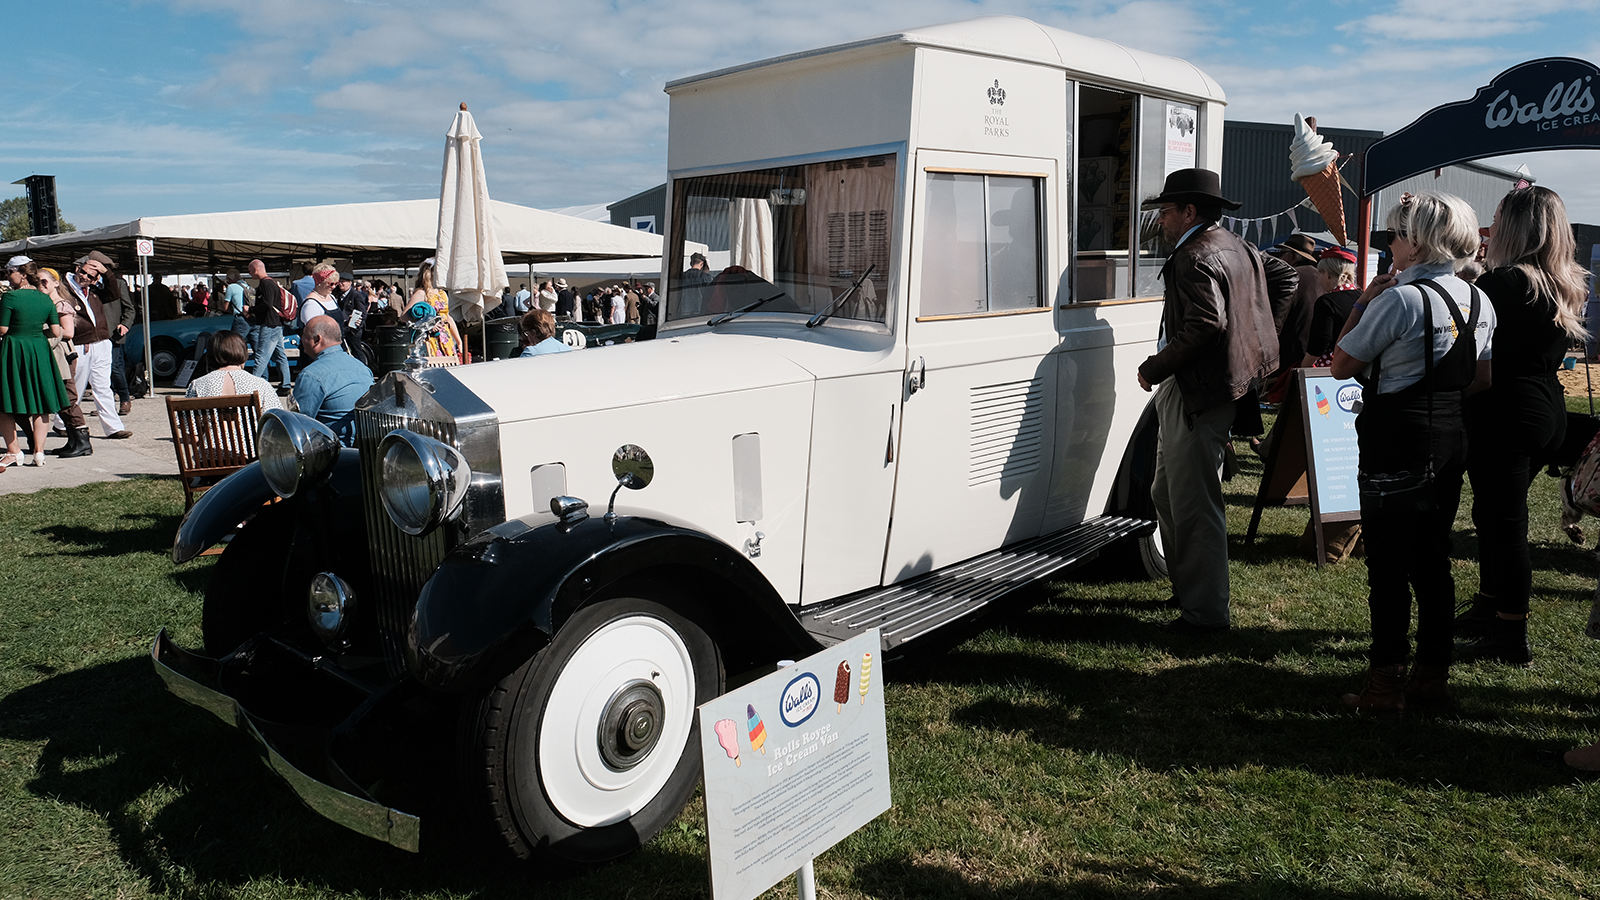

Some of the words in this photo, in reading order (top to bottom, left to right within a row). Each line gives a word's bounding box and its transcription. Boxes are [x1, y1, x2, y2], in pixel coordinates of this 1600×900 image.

[1485, 75, 1595, 129] Wall's
[984, 115, 1010, 127] ROYAL
[1537, 120, 1559, 132] ICE
[1563, 112, 1600, 127] CREA
[984, 127, 1010, 138] PARKS
[565, 331, 580, 347] 31
[1343, 421, 1355, 430] Me
[785, 681, 812, 713] Wall's
[774, 739, 801, 761] Rolls
[802, 723, 831, 745] Royce
[767, 762, 784, 778] Ice
[785, 743, 819, 767] Cream
[820, 731, 839, 747] Van
